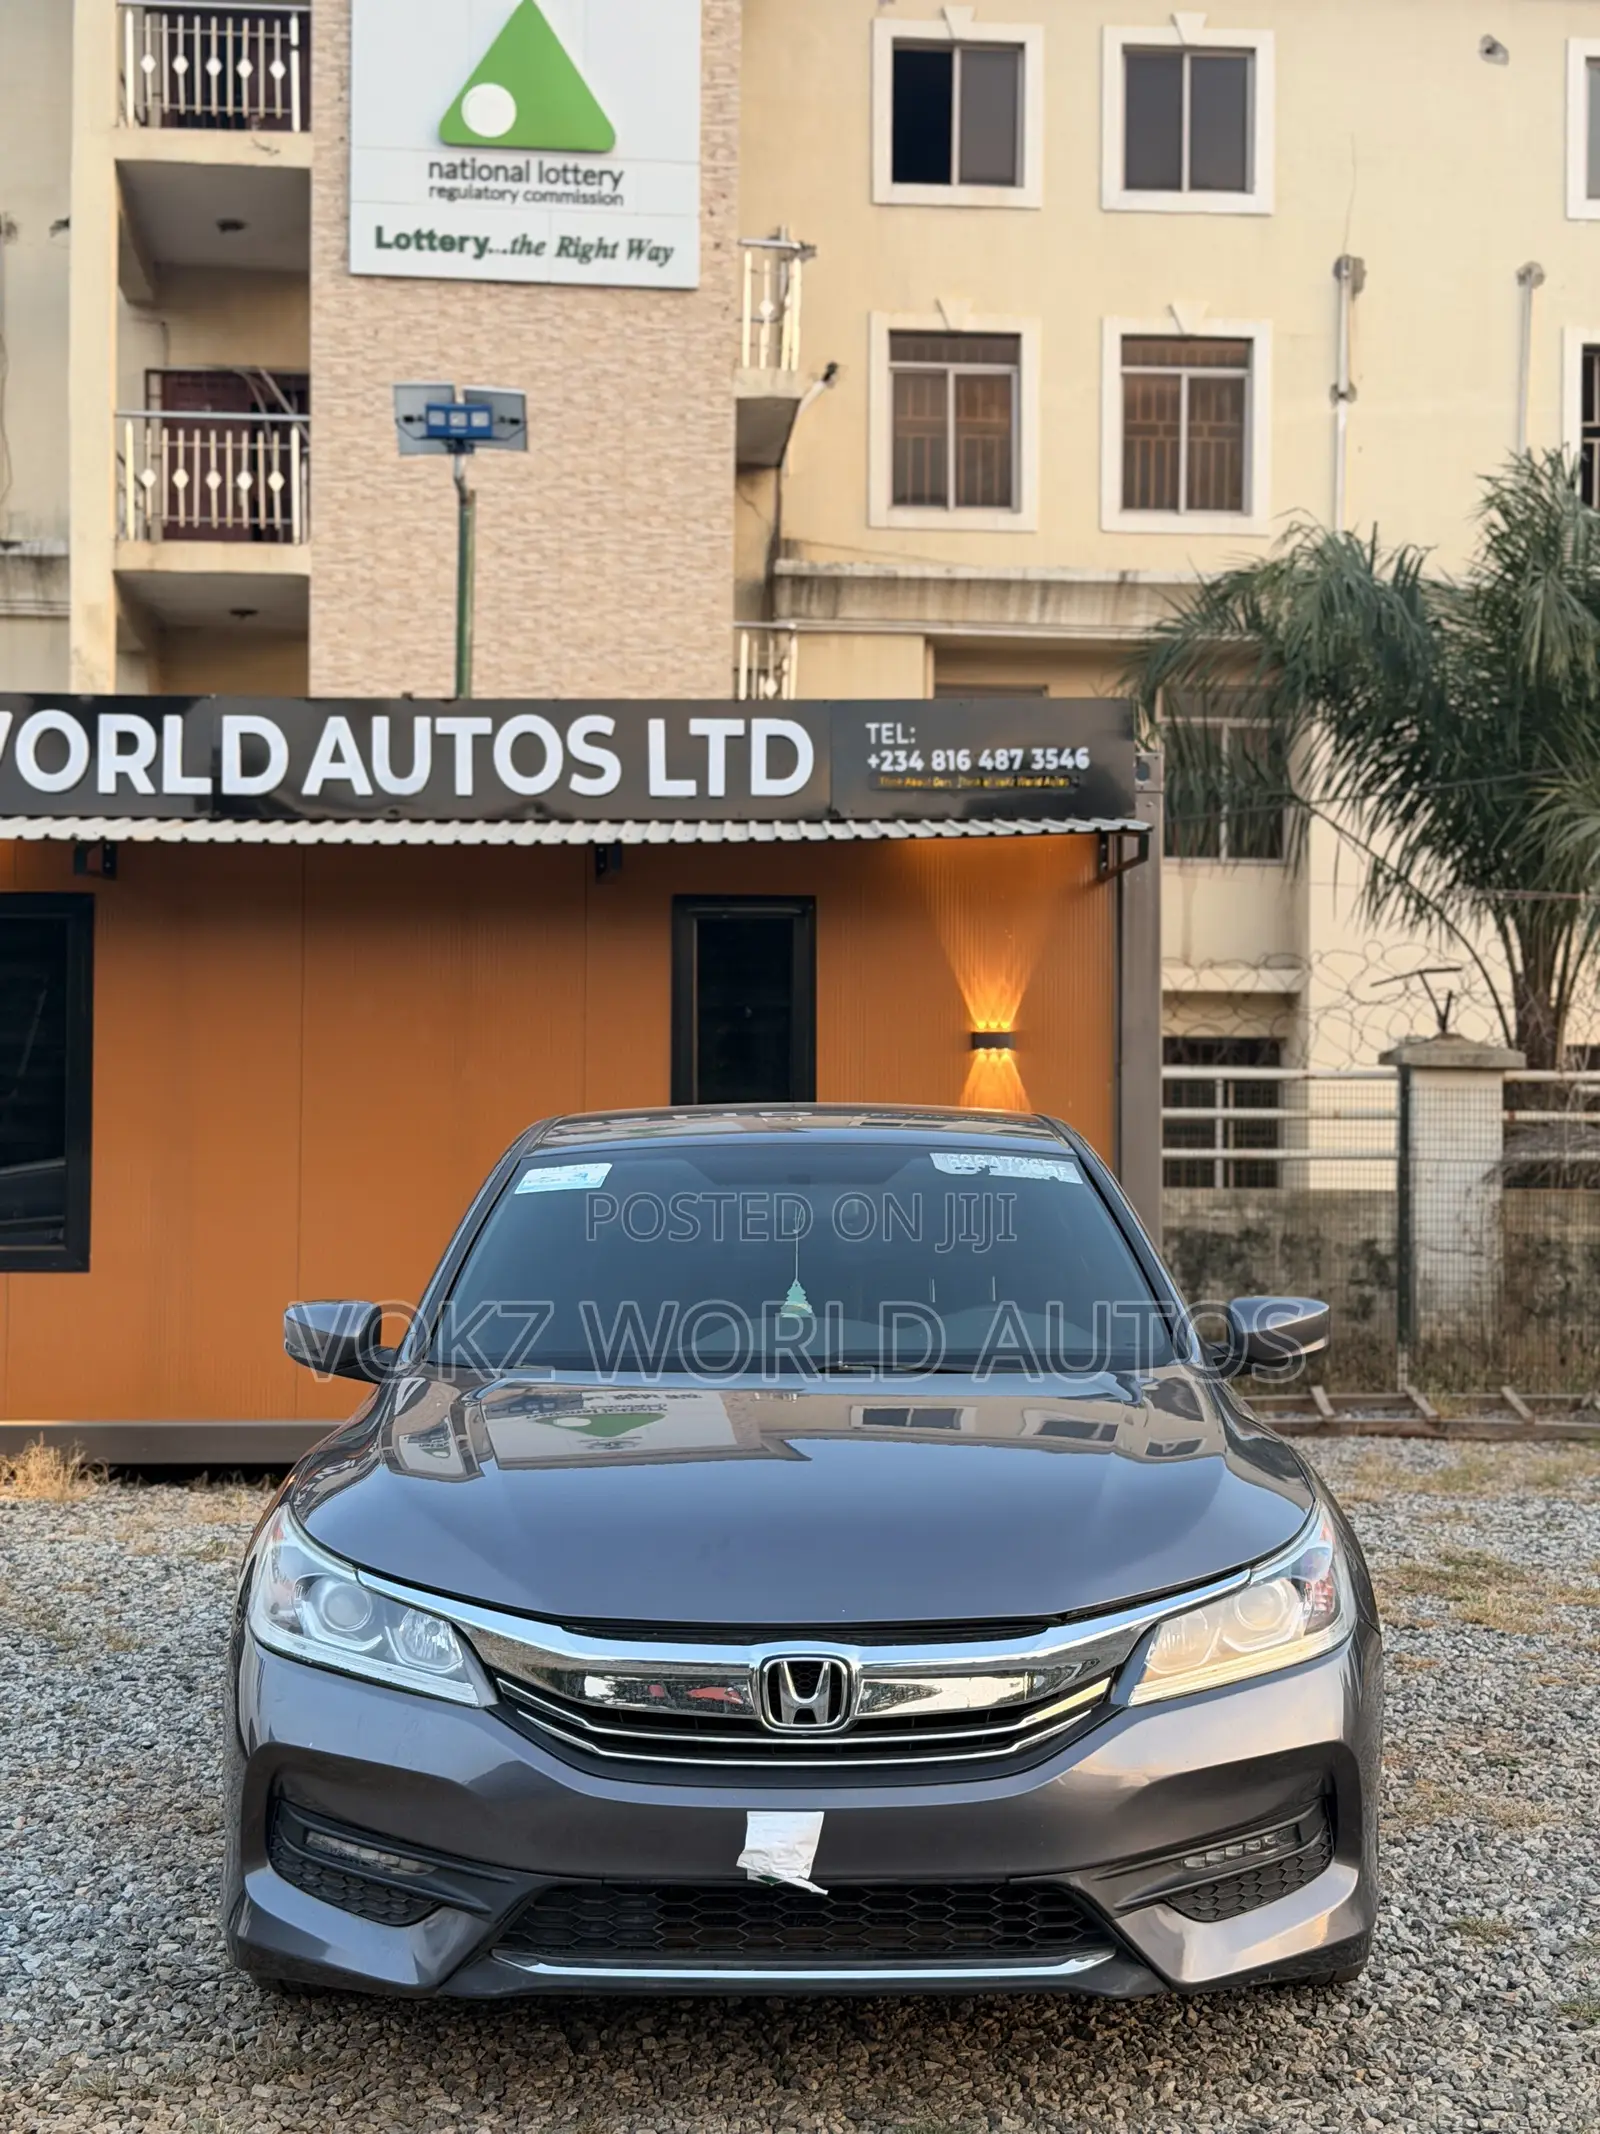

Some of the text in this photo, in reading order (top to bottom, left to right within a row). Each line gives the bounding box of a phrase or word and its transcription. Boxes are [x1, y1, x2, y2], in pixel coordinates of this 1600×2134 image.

[429, 157, 625, 191] national lottery
[429, 185, 625, 207] regulatory commission
[556, 236, 621, 266] Right
[627, 238, 675, 269] Way
[865, 722, 916, 745] TEL:
[302, 714, 623, 797] AUTOS
[648, 718, 815, 798] LTD
[867, 746, 1091, 773] +234 816 487 3546
